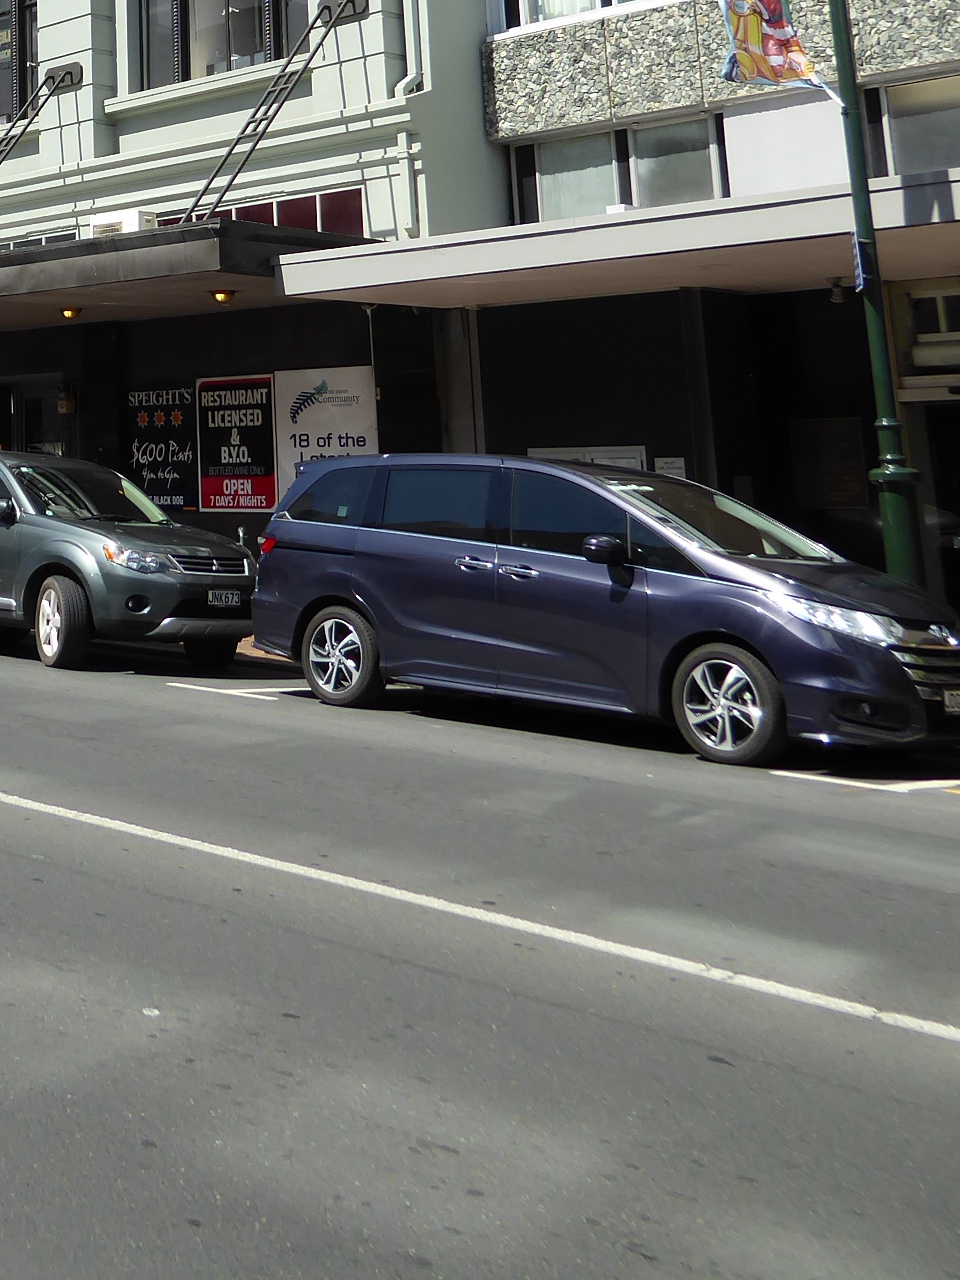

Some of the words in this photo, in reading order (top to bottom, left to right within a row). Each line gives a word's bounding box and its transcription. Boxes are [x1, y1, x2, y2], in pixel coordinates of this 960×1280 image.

[128, 388, 192, 407] SPEIGHT'S
[201, 388, 268, 407] RESTAURANT
[317, 394, 360, 405] Community
[208, 409, 262, 428] LICENSED
[230, 428, 240, 445] &
[289, 433, 310, 448] 18
[316, 433, 333, 448] of
[338, 432, 367, 448] the
[168, 440, 193, 464] Pints
[221, 446, 252, 464] B.Y.O.
[142, 466, 157, 489] 4pm
[157, 466, 165, 479] to
[164, 466, 180, 490] 6pm
[208, 467, 234, 476] BOTTLED
[234, 467, 249, 475] WINE
[250, 466, 265, 475] ONLY
[223, 479, 252, 495] OPEN
[153, 496, 171, 505] BLACK
[172, 496, 184, 505] DOG
[210, 496, 215, 507] 7
[215, 496, 234, 507] DAYS
[239, 496, 267, 507] NIGHTS
